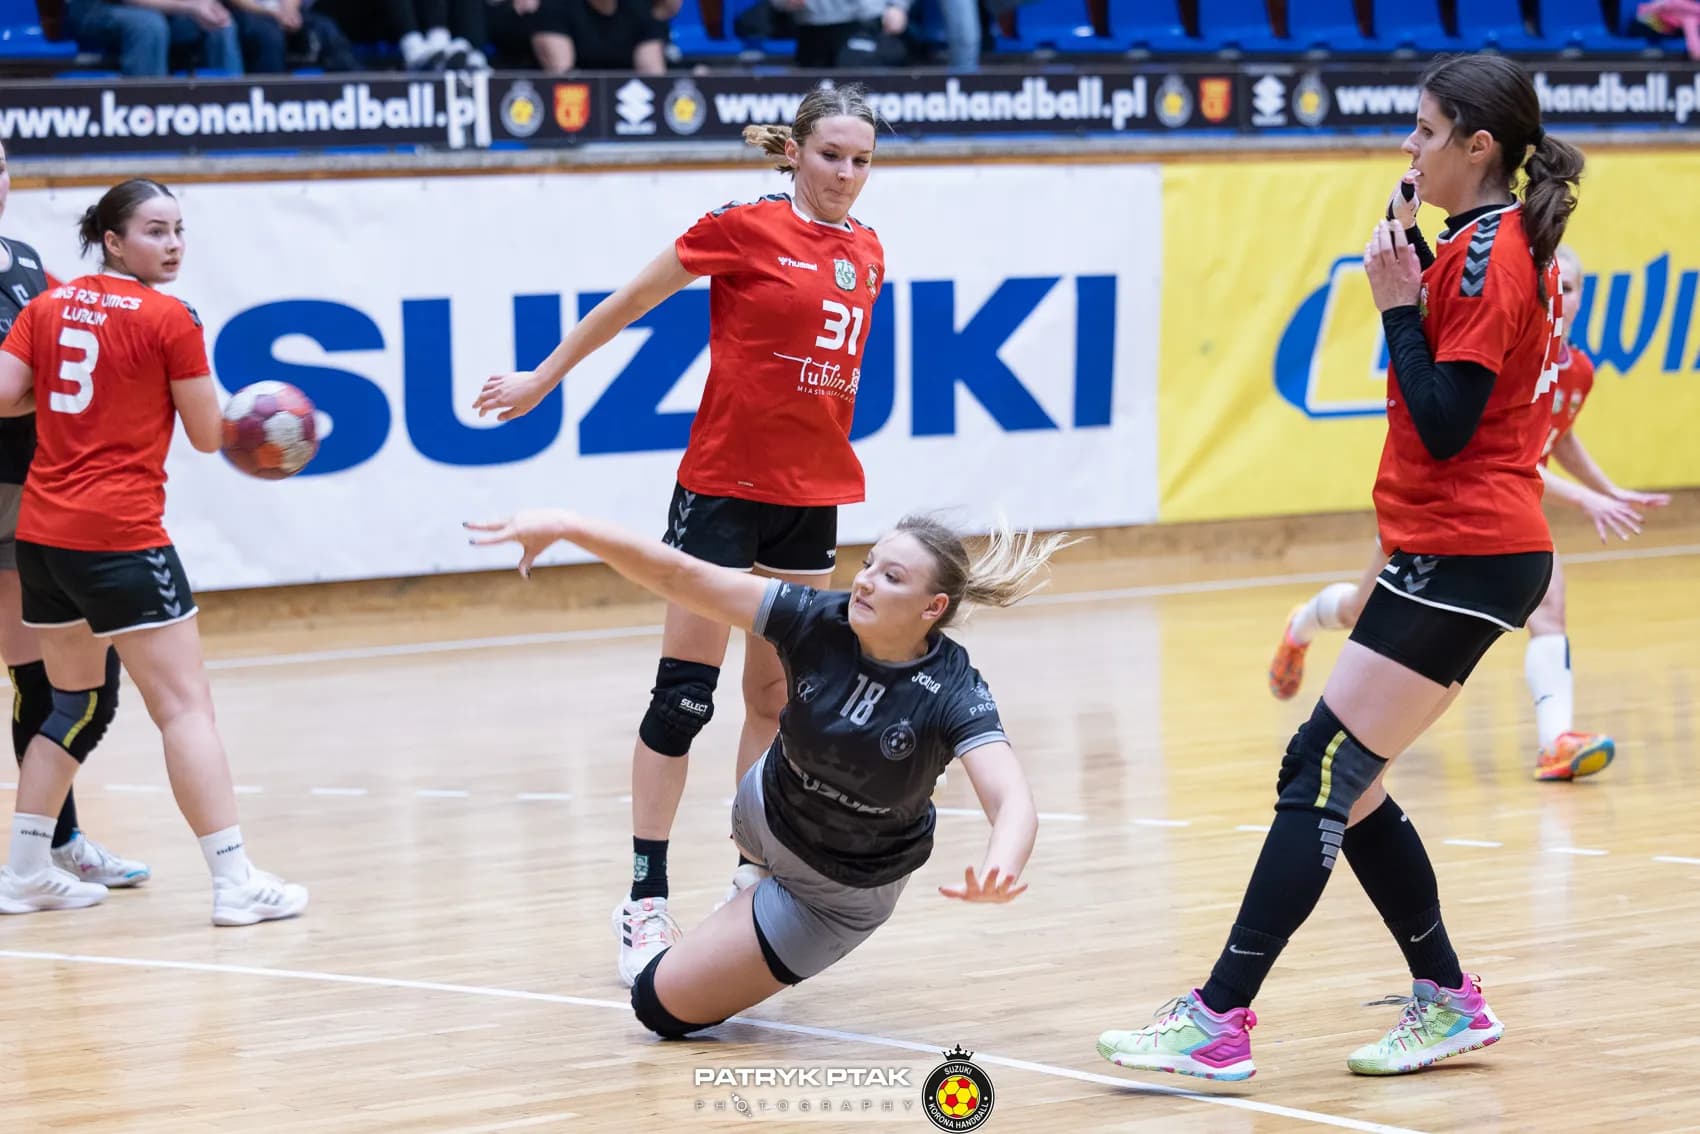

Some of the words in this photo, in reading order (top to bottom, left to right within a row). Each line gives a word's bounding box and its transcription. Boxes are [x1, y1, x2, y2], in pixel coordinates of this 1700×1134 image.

[815, 299, 864, 356] 31
[49, 326, 100, 415] 3
[839, 672, 886, 726] 18
